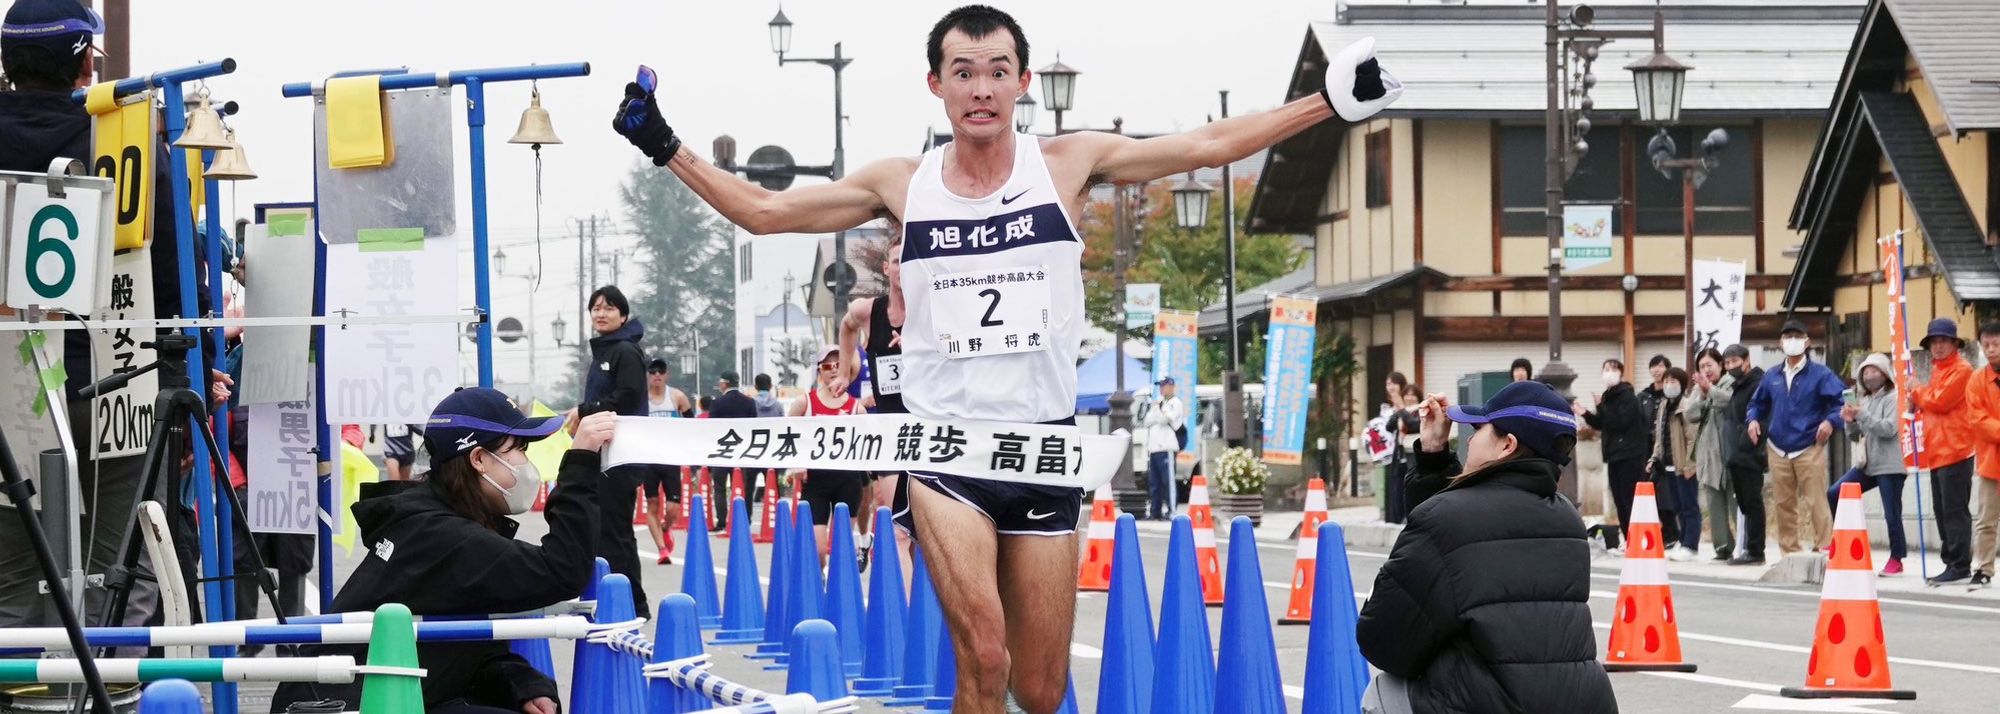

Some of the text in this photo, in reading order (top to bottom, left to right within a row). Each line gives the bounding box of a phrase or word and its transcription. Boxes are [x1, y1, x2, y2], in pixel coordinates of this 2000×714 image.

[25, 204, 79, 299] 6
[929, 214, 1036, 250] 旭化成
[933, 270, 1046, 291] 全日本35km競歩高畠大会
[978, 288, 1004, 327] 2
[949, 338, 983, 353] 川野
[98, 394, 153, 453] 20km
[707, 426, 801, 460] 全日本
[810, 426, 883, 460] 35km
[895, 423, 967, 463] 競歩
